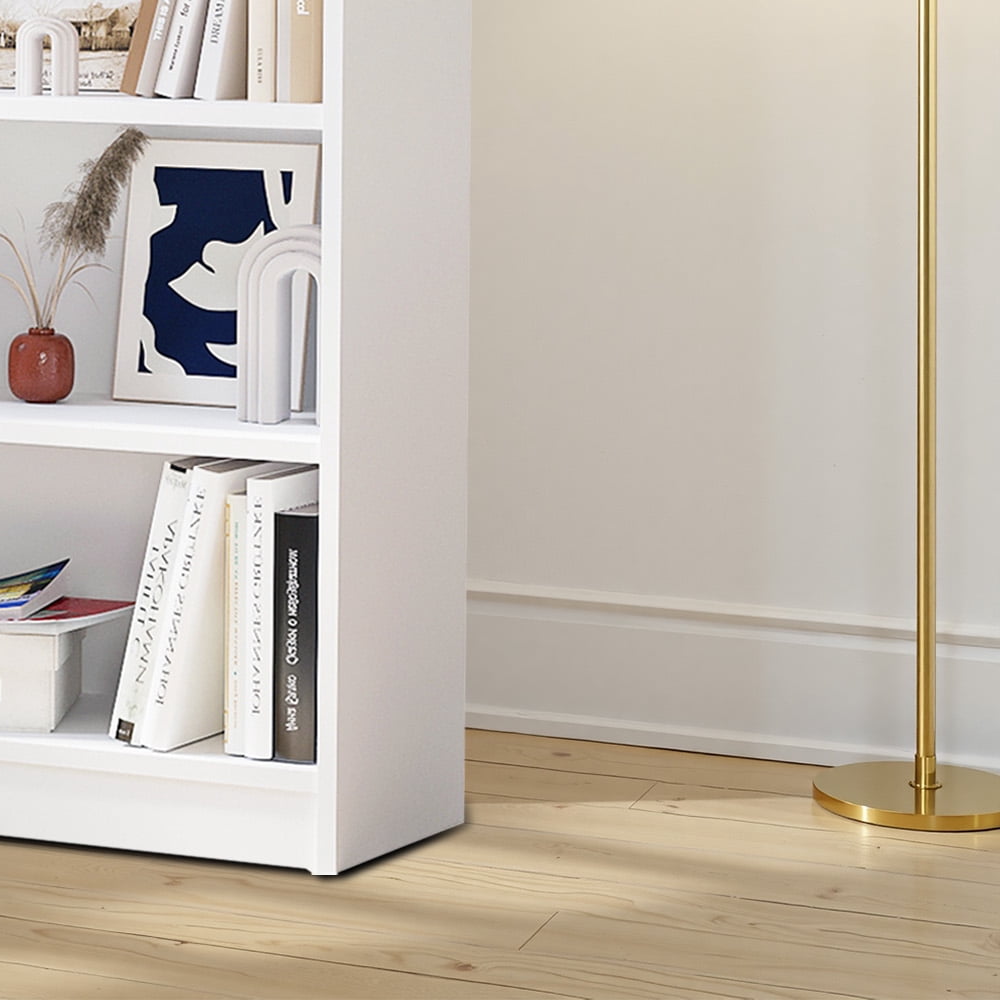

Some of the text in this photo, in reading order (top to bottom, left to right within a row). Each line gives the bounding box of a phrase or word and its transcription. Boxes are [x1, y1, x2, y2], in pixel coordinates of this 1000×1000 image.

[153, 17, 166, 41] THIS
[161, 5, 169, 17] IS
[179, 4, 191, 18] for
